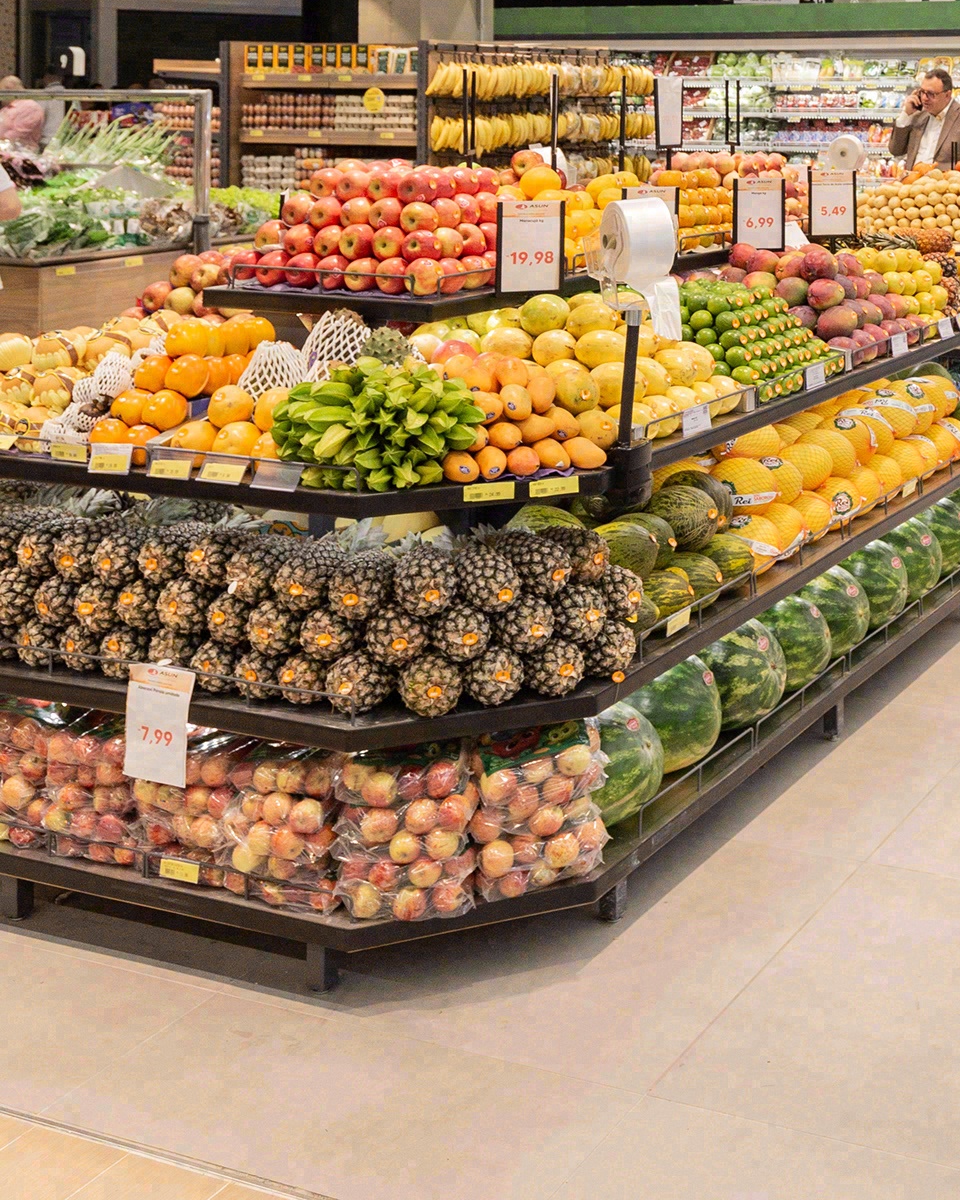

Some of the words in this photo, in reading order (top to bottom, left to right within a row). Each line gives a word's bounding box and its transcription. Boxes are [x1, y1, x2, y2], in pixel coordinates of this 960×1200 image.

[821, 206, 847, 217] 5,49
[745, 217, 774, 229] 6,99
[510, 251, 554, 267] 19,98
[734, 495, 752, 505] Rei
[141, 725, 173, 747] 7,99
